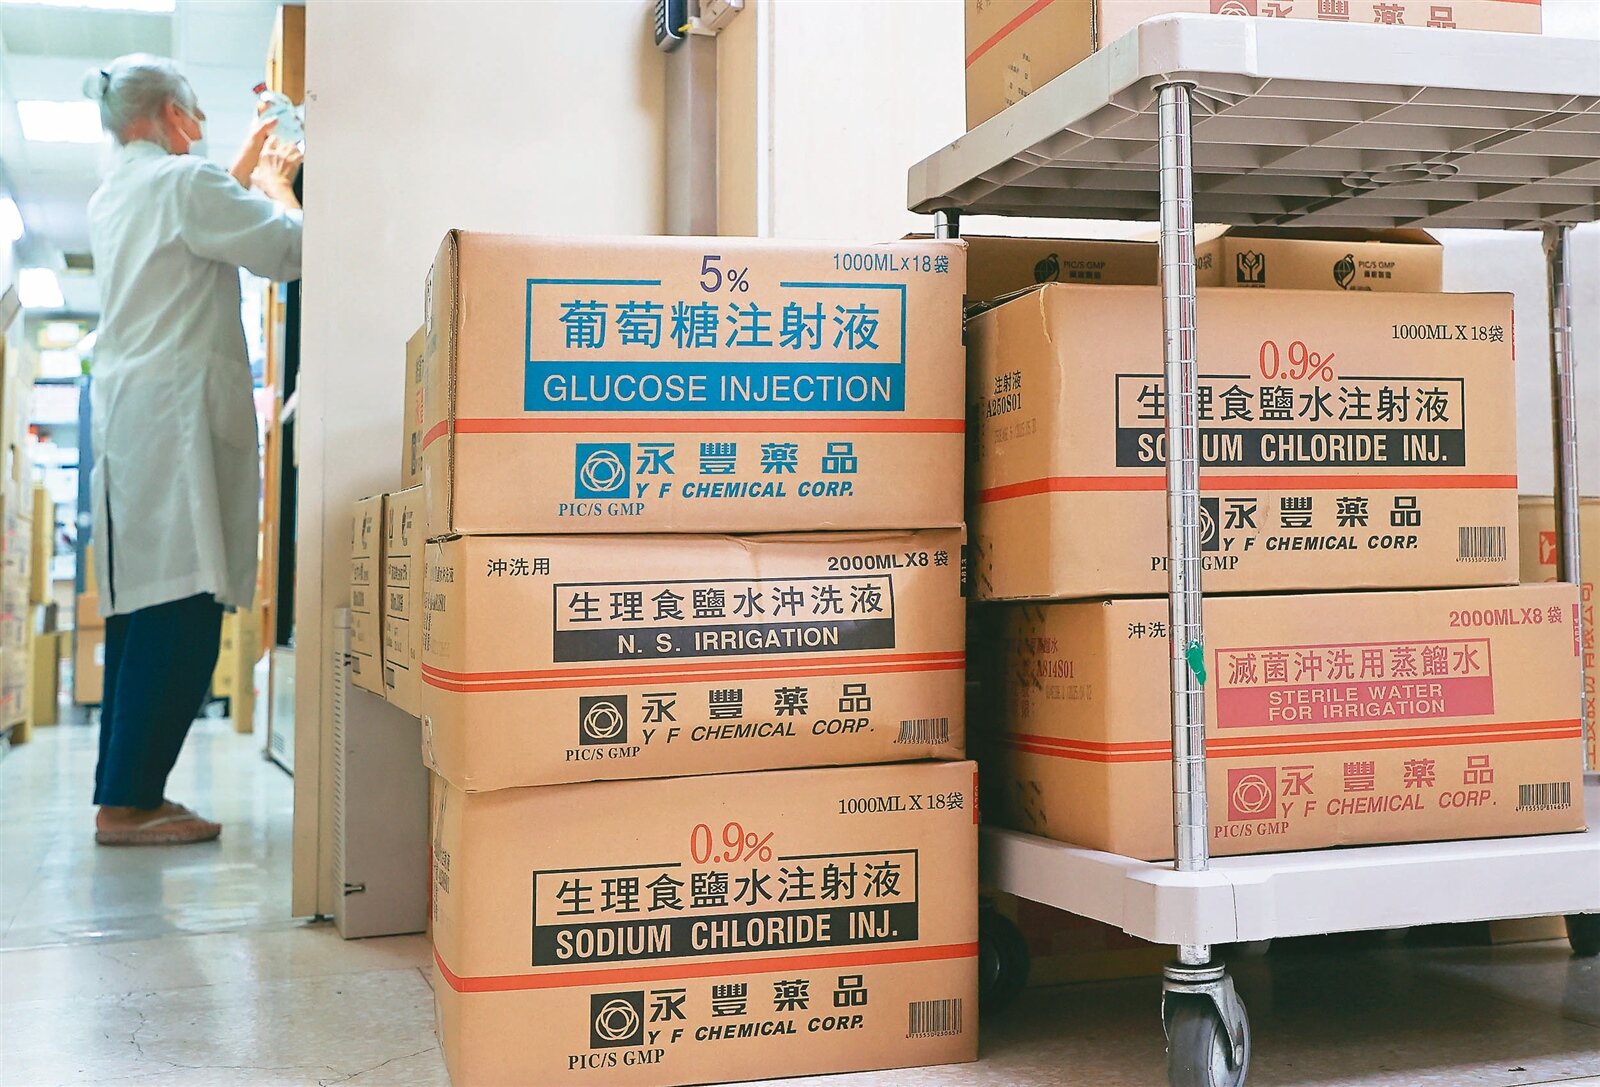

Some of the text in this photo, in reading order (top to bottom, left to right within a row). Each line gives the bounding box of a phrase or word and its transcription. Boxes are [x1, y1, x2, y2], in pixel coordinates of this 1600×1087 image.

[700, 255, 749, 293] 5%
[559, 300, 880, 351] 葡萄糖注射液
[1455, 325, 1468, 340] X
[1260, 341, 1335, 383] 0.9%
[543, 374, 892, 403] GLUCOSE INJECTION
[1137, 433, 1448, 463] SOUM CHLORIDE INJ.
[637, 481, 854, 498] Y F CHEMICAL CORP.
[559, 503, 645, 518] PIC/S GMP
[1223, 535, 1419, 551] Y F CHEMICAL CORP.
[487, 557, 550, 577] 沖洗用
[1202, 556, 1239, 570] GMP
[568, 583, 884, 623] 生理食鹽水沖洗液
[618, 627, 839, 654] N. S. IRRIGATION
[1228, 644, 1481, 685] 滅菌沖洗用蒸餾水
[1269, 683, 1443, 706] STERILE WATER
[1269, 699, 1446, 721] FOR IRRIGATION
[642, 717, 875, 745] Y F CHEMICAL CORP.
[566, 745, 641, 762] PIC/S GMP
[908, 795, 923, 811] X
[1281, 790, 1497, 819] Y F CHEMICAL CORP.
[690, 821, 774, 864] 0.9%
[1214, 821, 1289, 839] PIC/S GMP
[555, 862, 902, 917] 生理食鹽水注射液
[556, 909, 899, 961] SODIUM CHLORIDE INJ.
[647, 1014, 864, 1046] Y F CHEMICAL CORP.
[568, 1048, 665, 1071] PIC/S GMP
